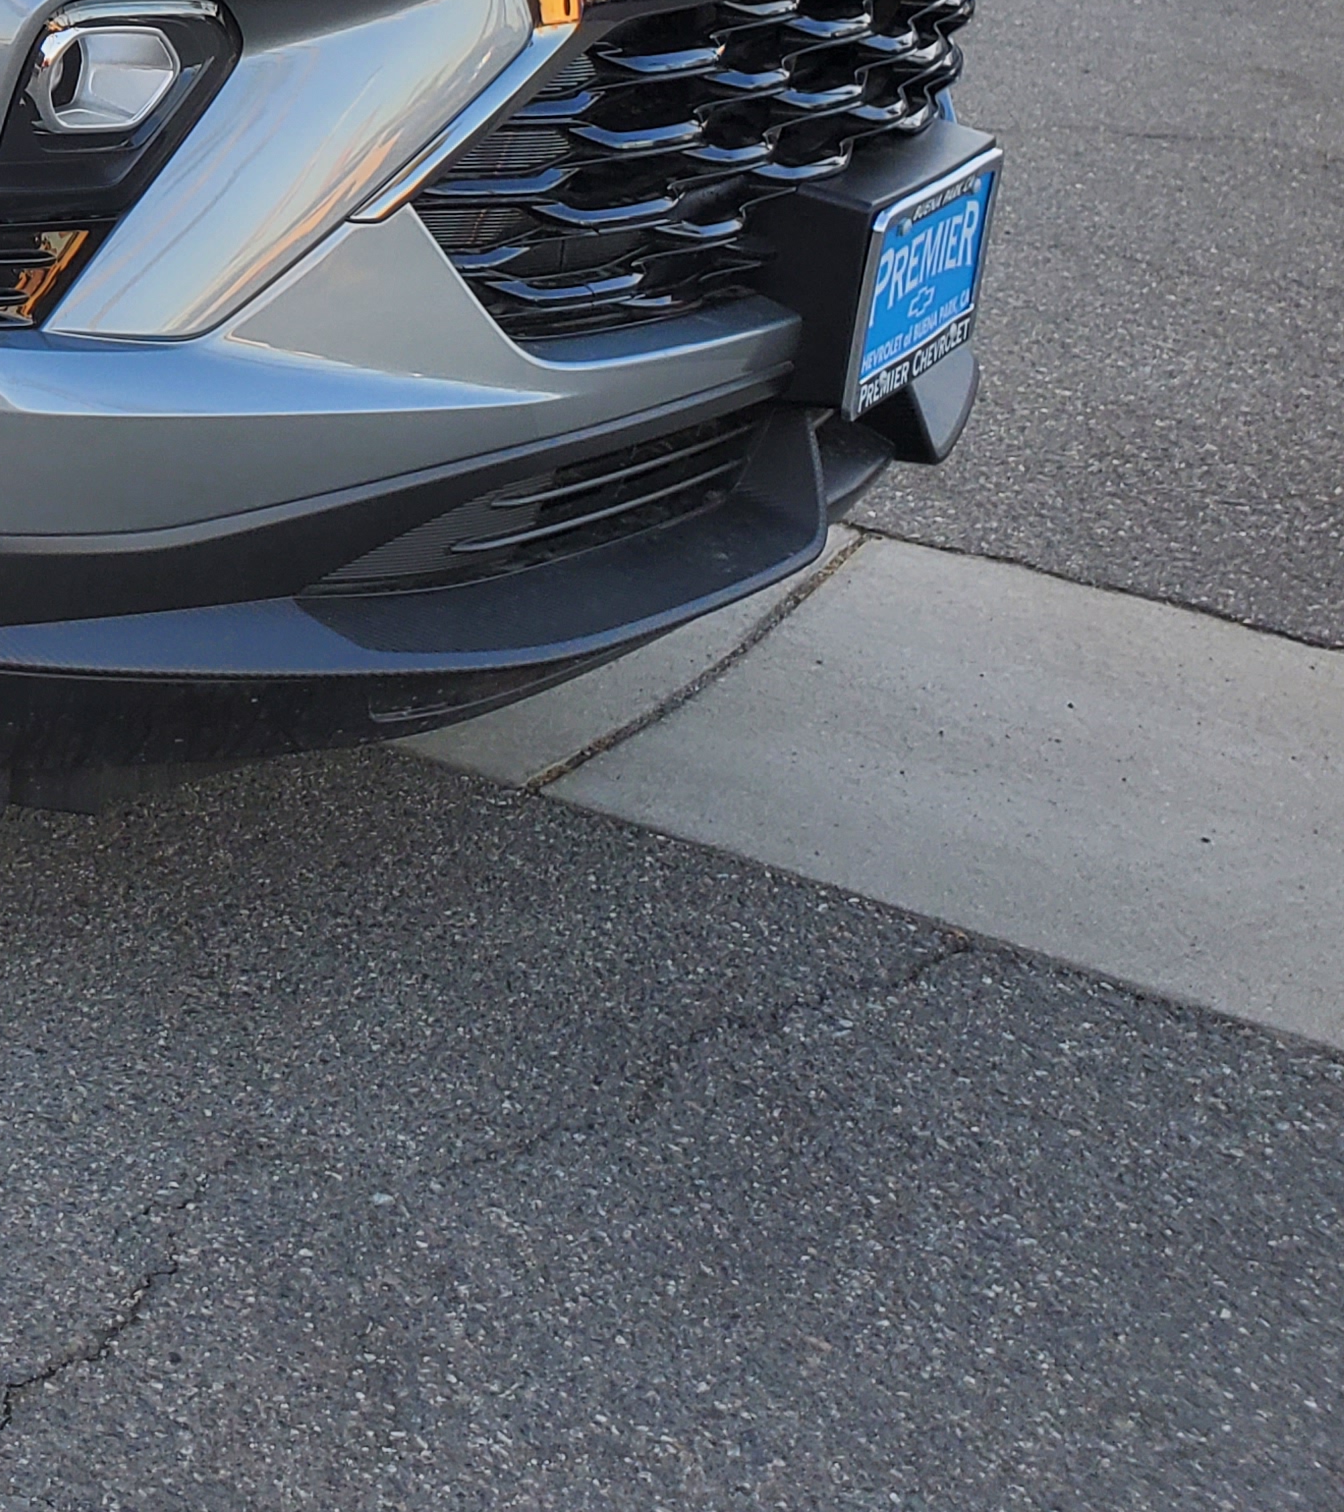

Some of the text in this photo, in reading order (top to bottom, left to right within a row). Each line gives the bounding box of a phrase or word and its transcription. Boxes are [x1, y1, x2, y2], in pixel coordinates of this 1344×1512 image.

[868, 200, 980, 329] PREMIER
[860, 332, 904, 375] HEVROLET
[913, 310, 939, 343] BUENA
[959, 287, 972, 310] CA
